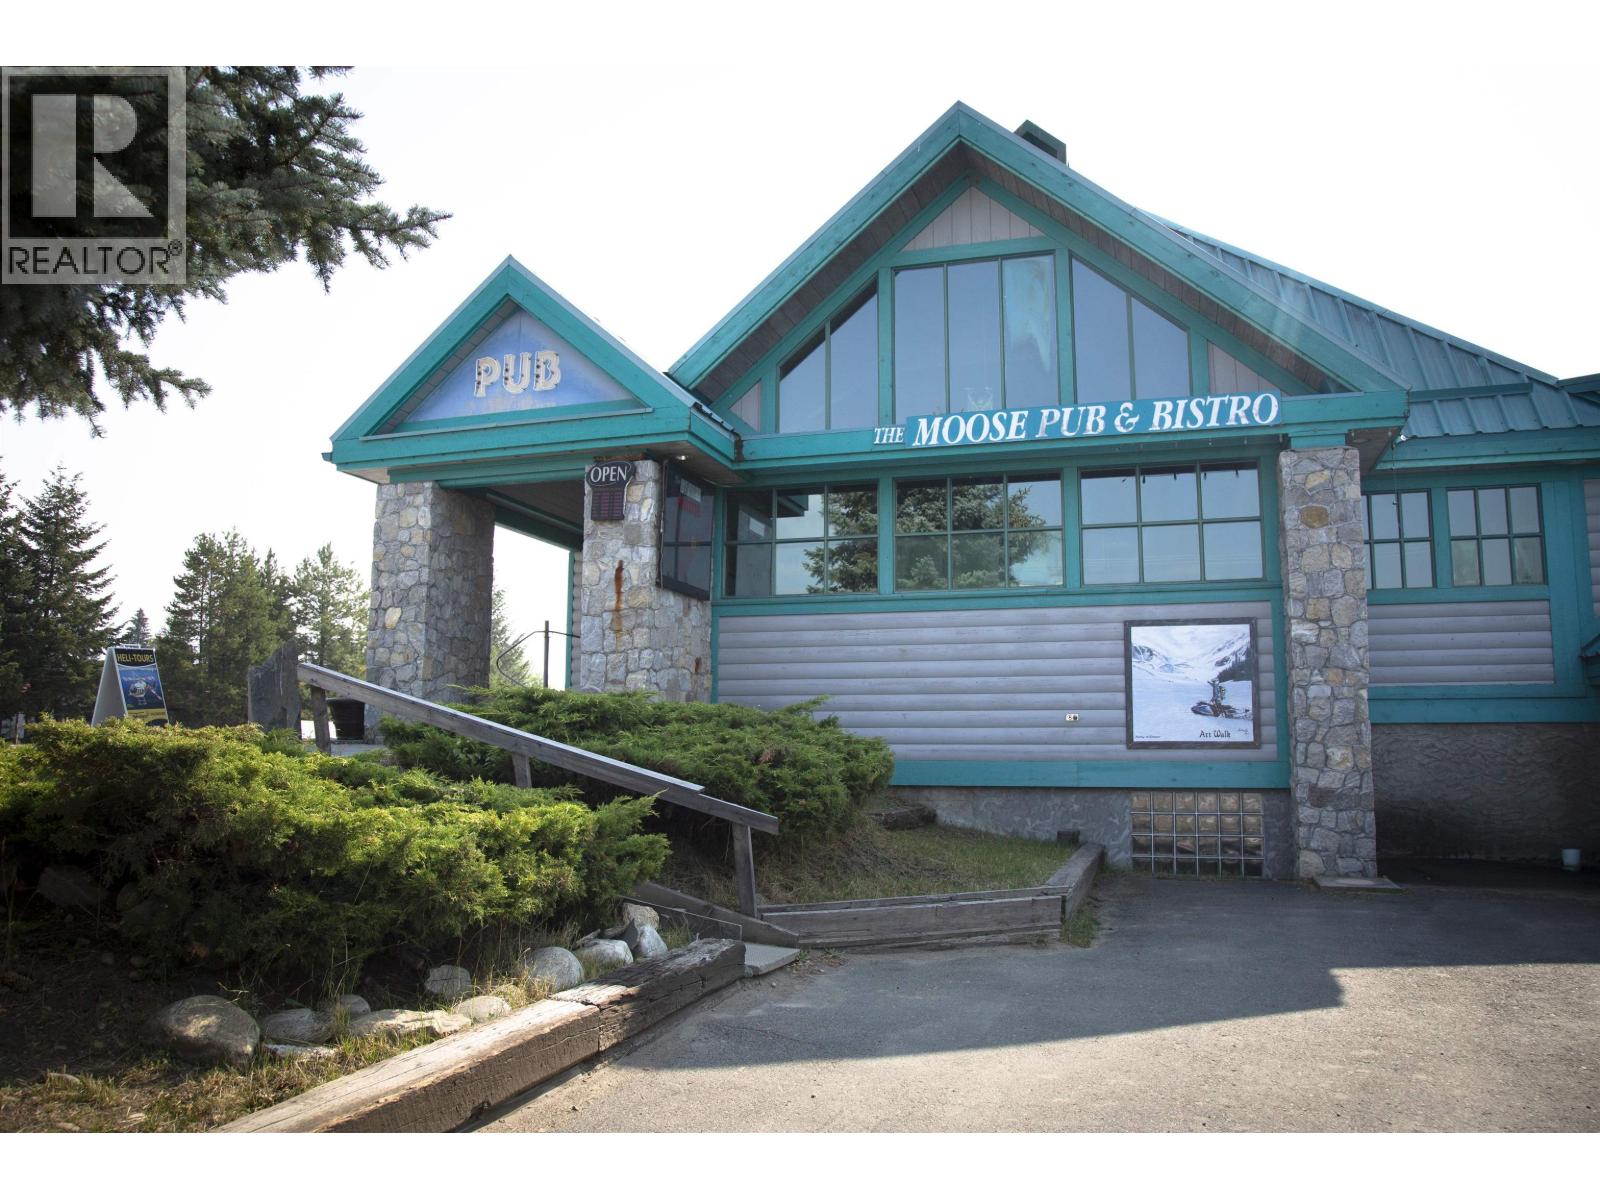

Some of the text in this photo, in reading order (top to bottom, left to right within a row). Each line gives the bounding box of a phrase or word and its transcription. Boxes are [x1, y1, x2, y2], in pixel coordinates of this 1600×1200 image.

[474, 349, 561, 397] PUB
[873, 393, 1279, 446] THE MOOSE PUB & BISTRO
[590, 466, 629, 483] OPEN
[117, 653, 154, 663] HELI-TOURS
[1199, 730, 1212, 738] Art
[1213, 729, 1231, 738] Walk
